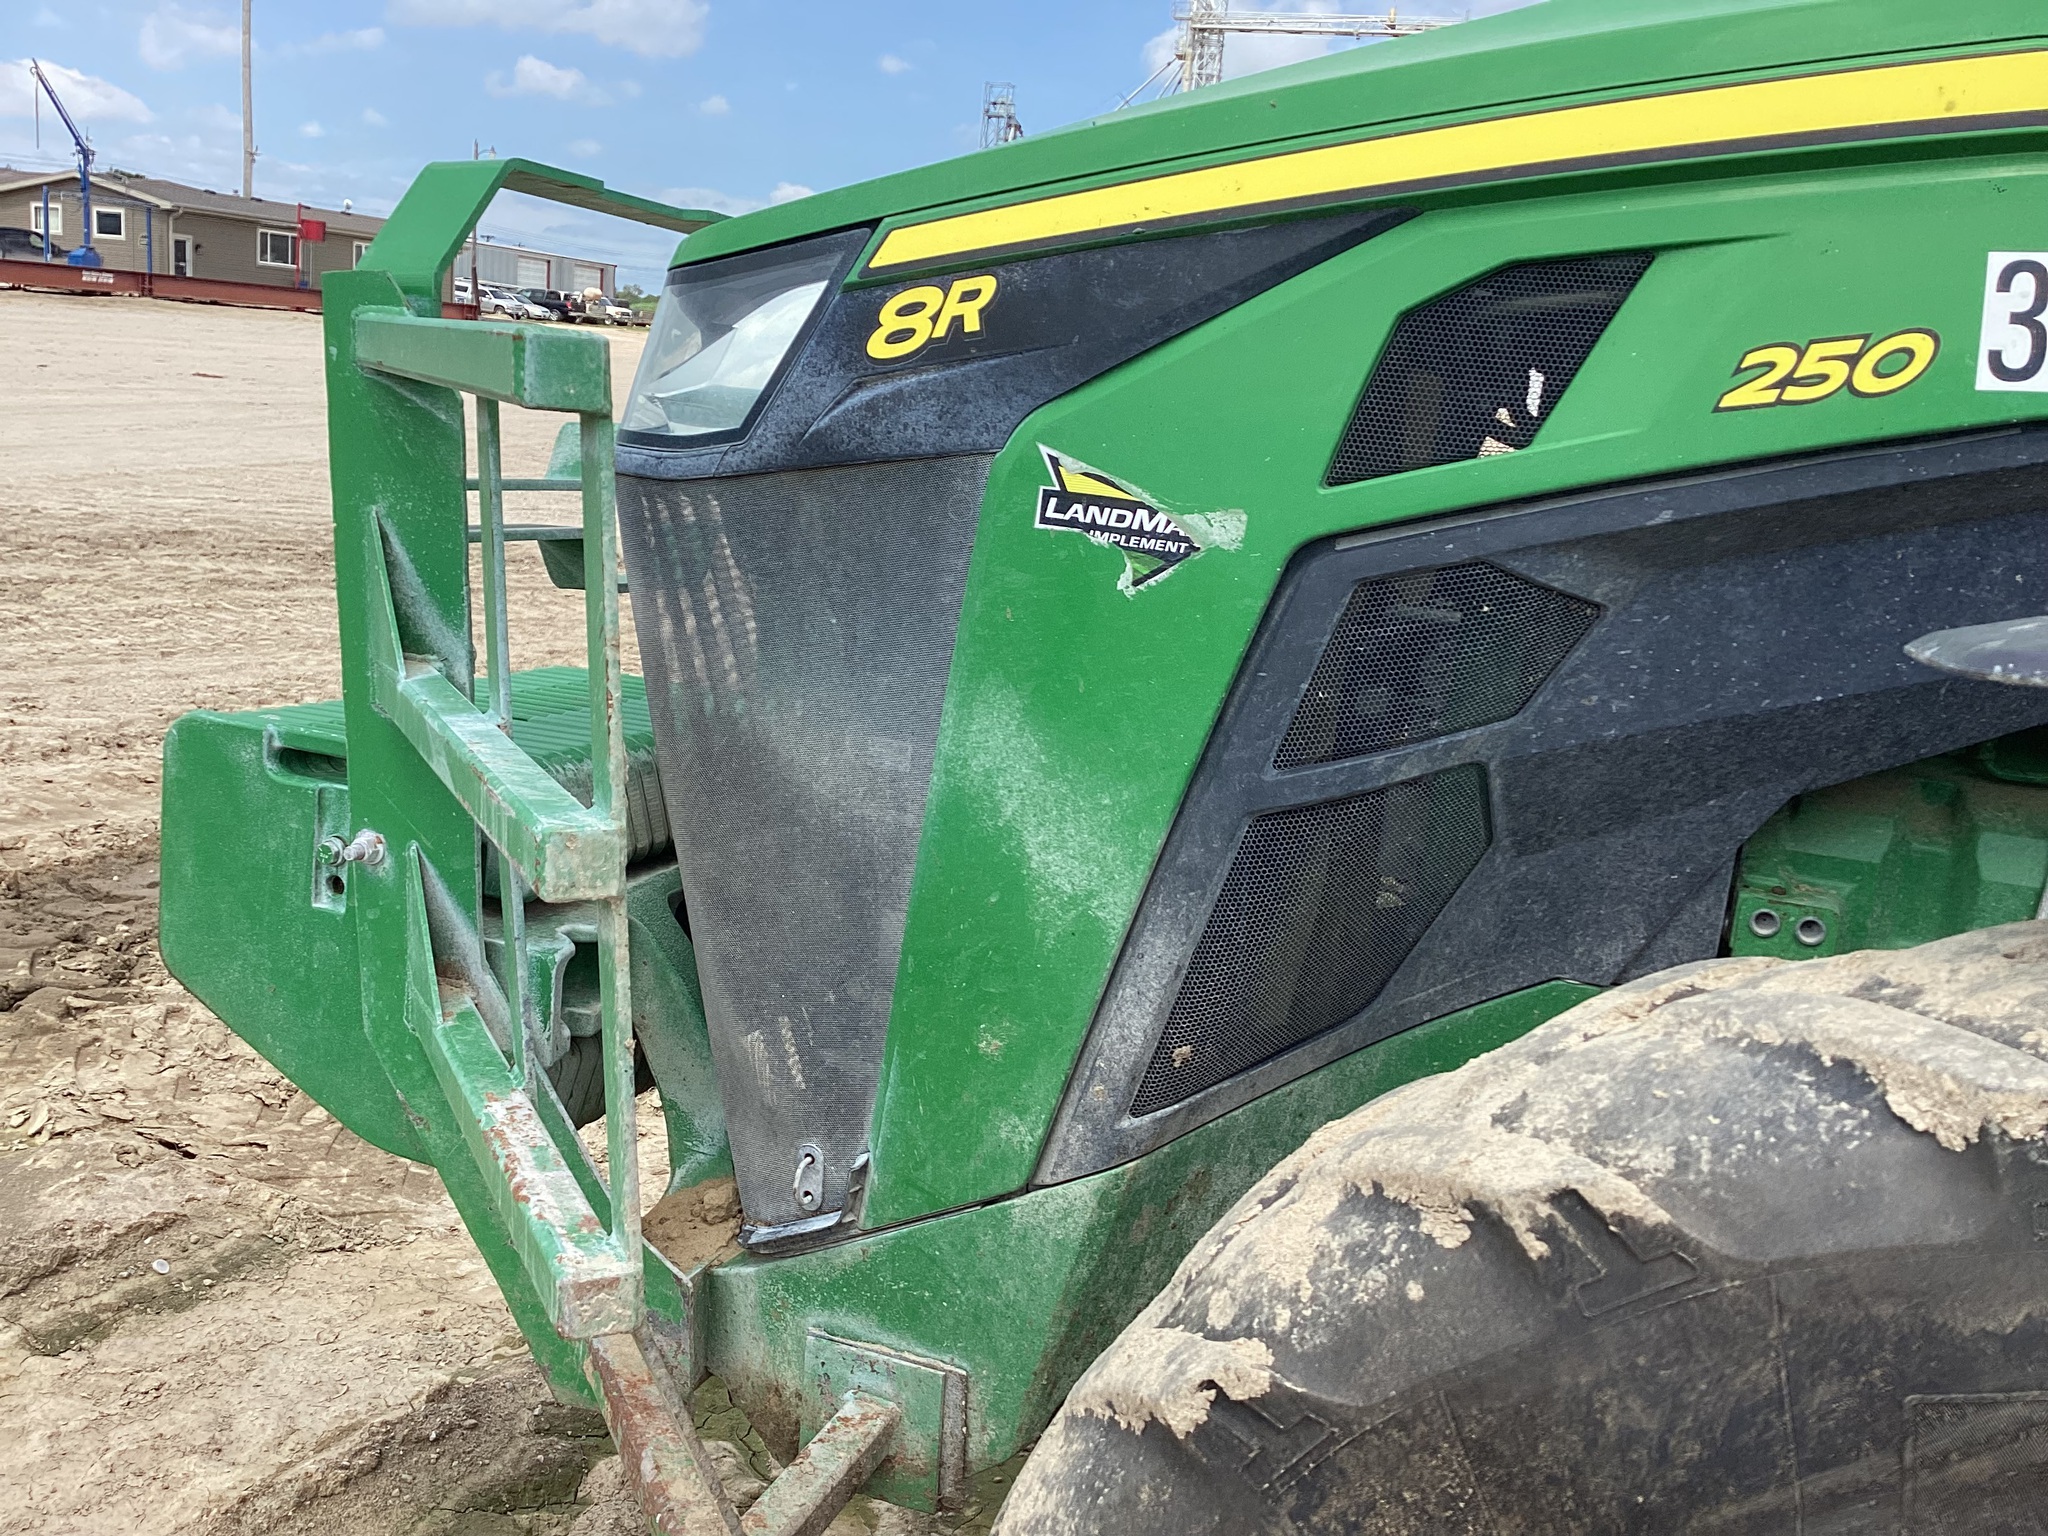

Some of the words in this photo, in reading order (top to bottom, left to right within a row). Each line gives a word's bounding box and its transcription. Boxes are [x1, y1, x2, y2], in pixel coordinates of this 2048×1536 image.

[866, 274, 998, 360] 8R
[1988, 259, 2048, 382] 3
[1713, 328, 1940, 411] 250
